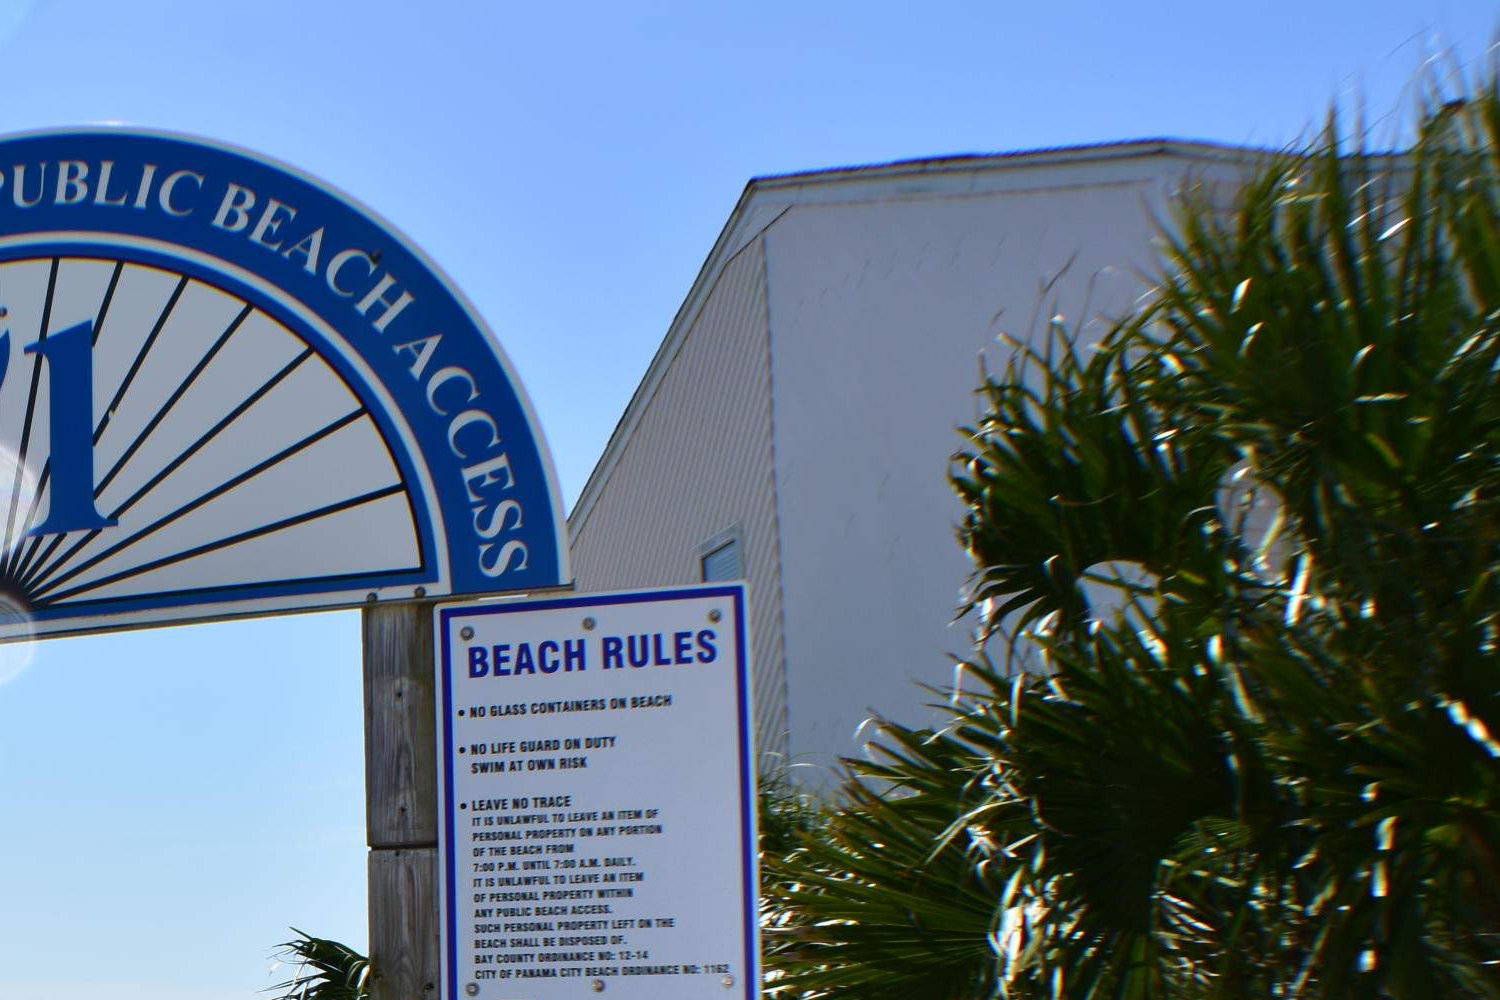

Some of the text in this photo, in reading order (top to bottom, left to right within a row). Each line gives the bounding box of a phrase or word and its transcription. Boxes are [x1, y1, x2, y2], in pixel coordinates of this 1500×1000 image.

[211, 181, 416, 334] BEACH
[391, 332, 530, 580] ACCESS
[468, 629, 718, 678] BEACH RULES
[470, 695, 672, 718] NO GLASS CONTAINERS ON BEACH
[471, 736, 616, 755] NO LIFE GUARD ON DUTY
[471, 757, 588, 774] SWIM AT OWN RISK
[471, 795, 571, 812] LEAVE NO TRACE
[472, 809, 659, 827] IT IS UNLAWFUL TO LEAVE AN ITEM OF
[473, 844, 574, 857] OF THE BEACH FROM
[473, 857, 636, 872] 7:00 P.M. UNTIL 7:00 A.M. DAILY.
[474, 905, 612, 918] ANY PUBLIC BEACH ACCESS.
[474, 935, 627, 949] BEACH SHALL BE DISPOSED OF.
